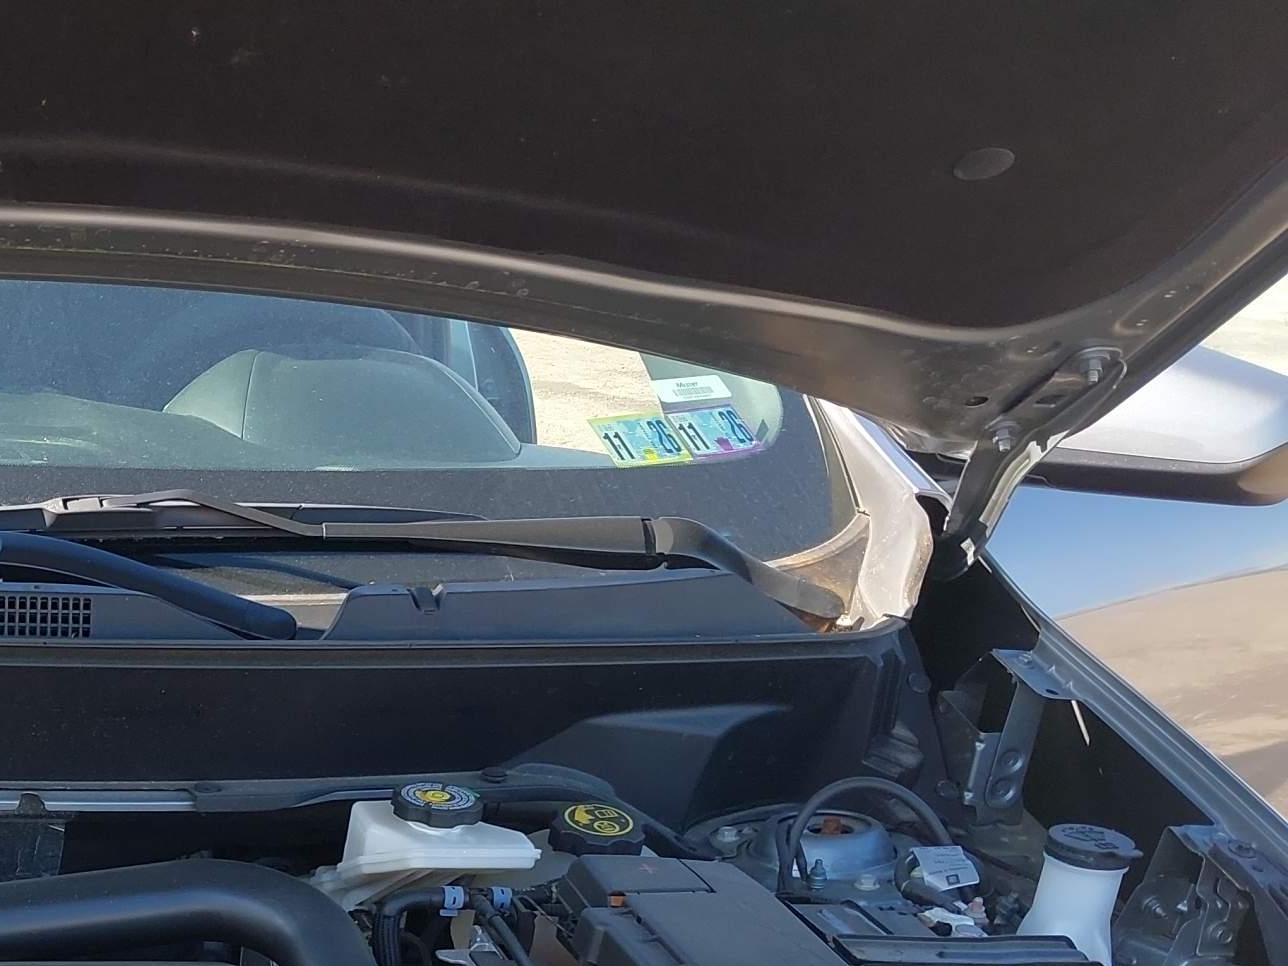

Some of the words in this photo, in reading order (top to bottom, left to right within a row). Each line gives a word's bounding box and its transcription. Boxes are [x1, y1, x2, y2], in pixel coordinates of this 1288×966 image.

[646, 418, 682, 454] 26
[678, 422, 711, 451] 11
[717, 409, 756, 444] 26
[602, 431, 636, 461] 11
